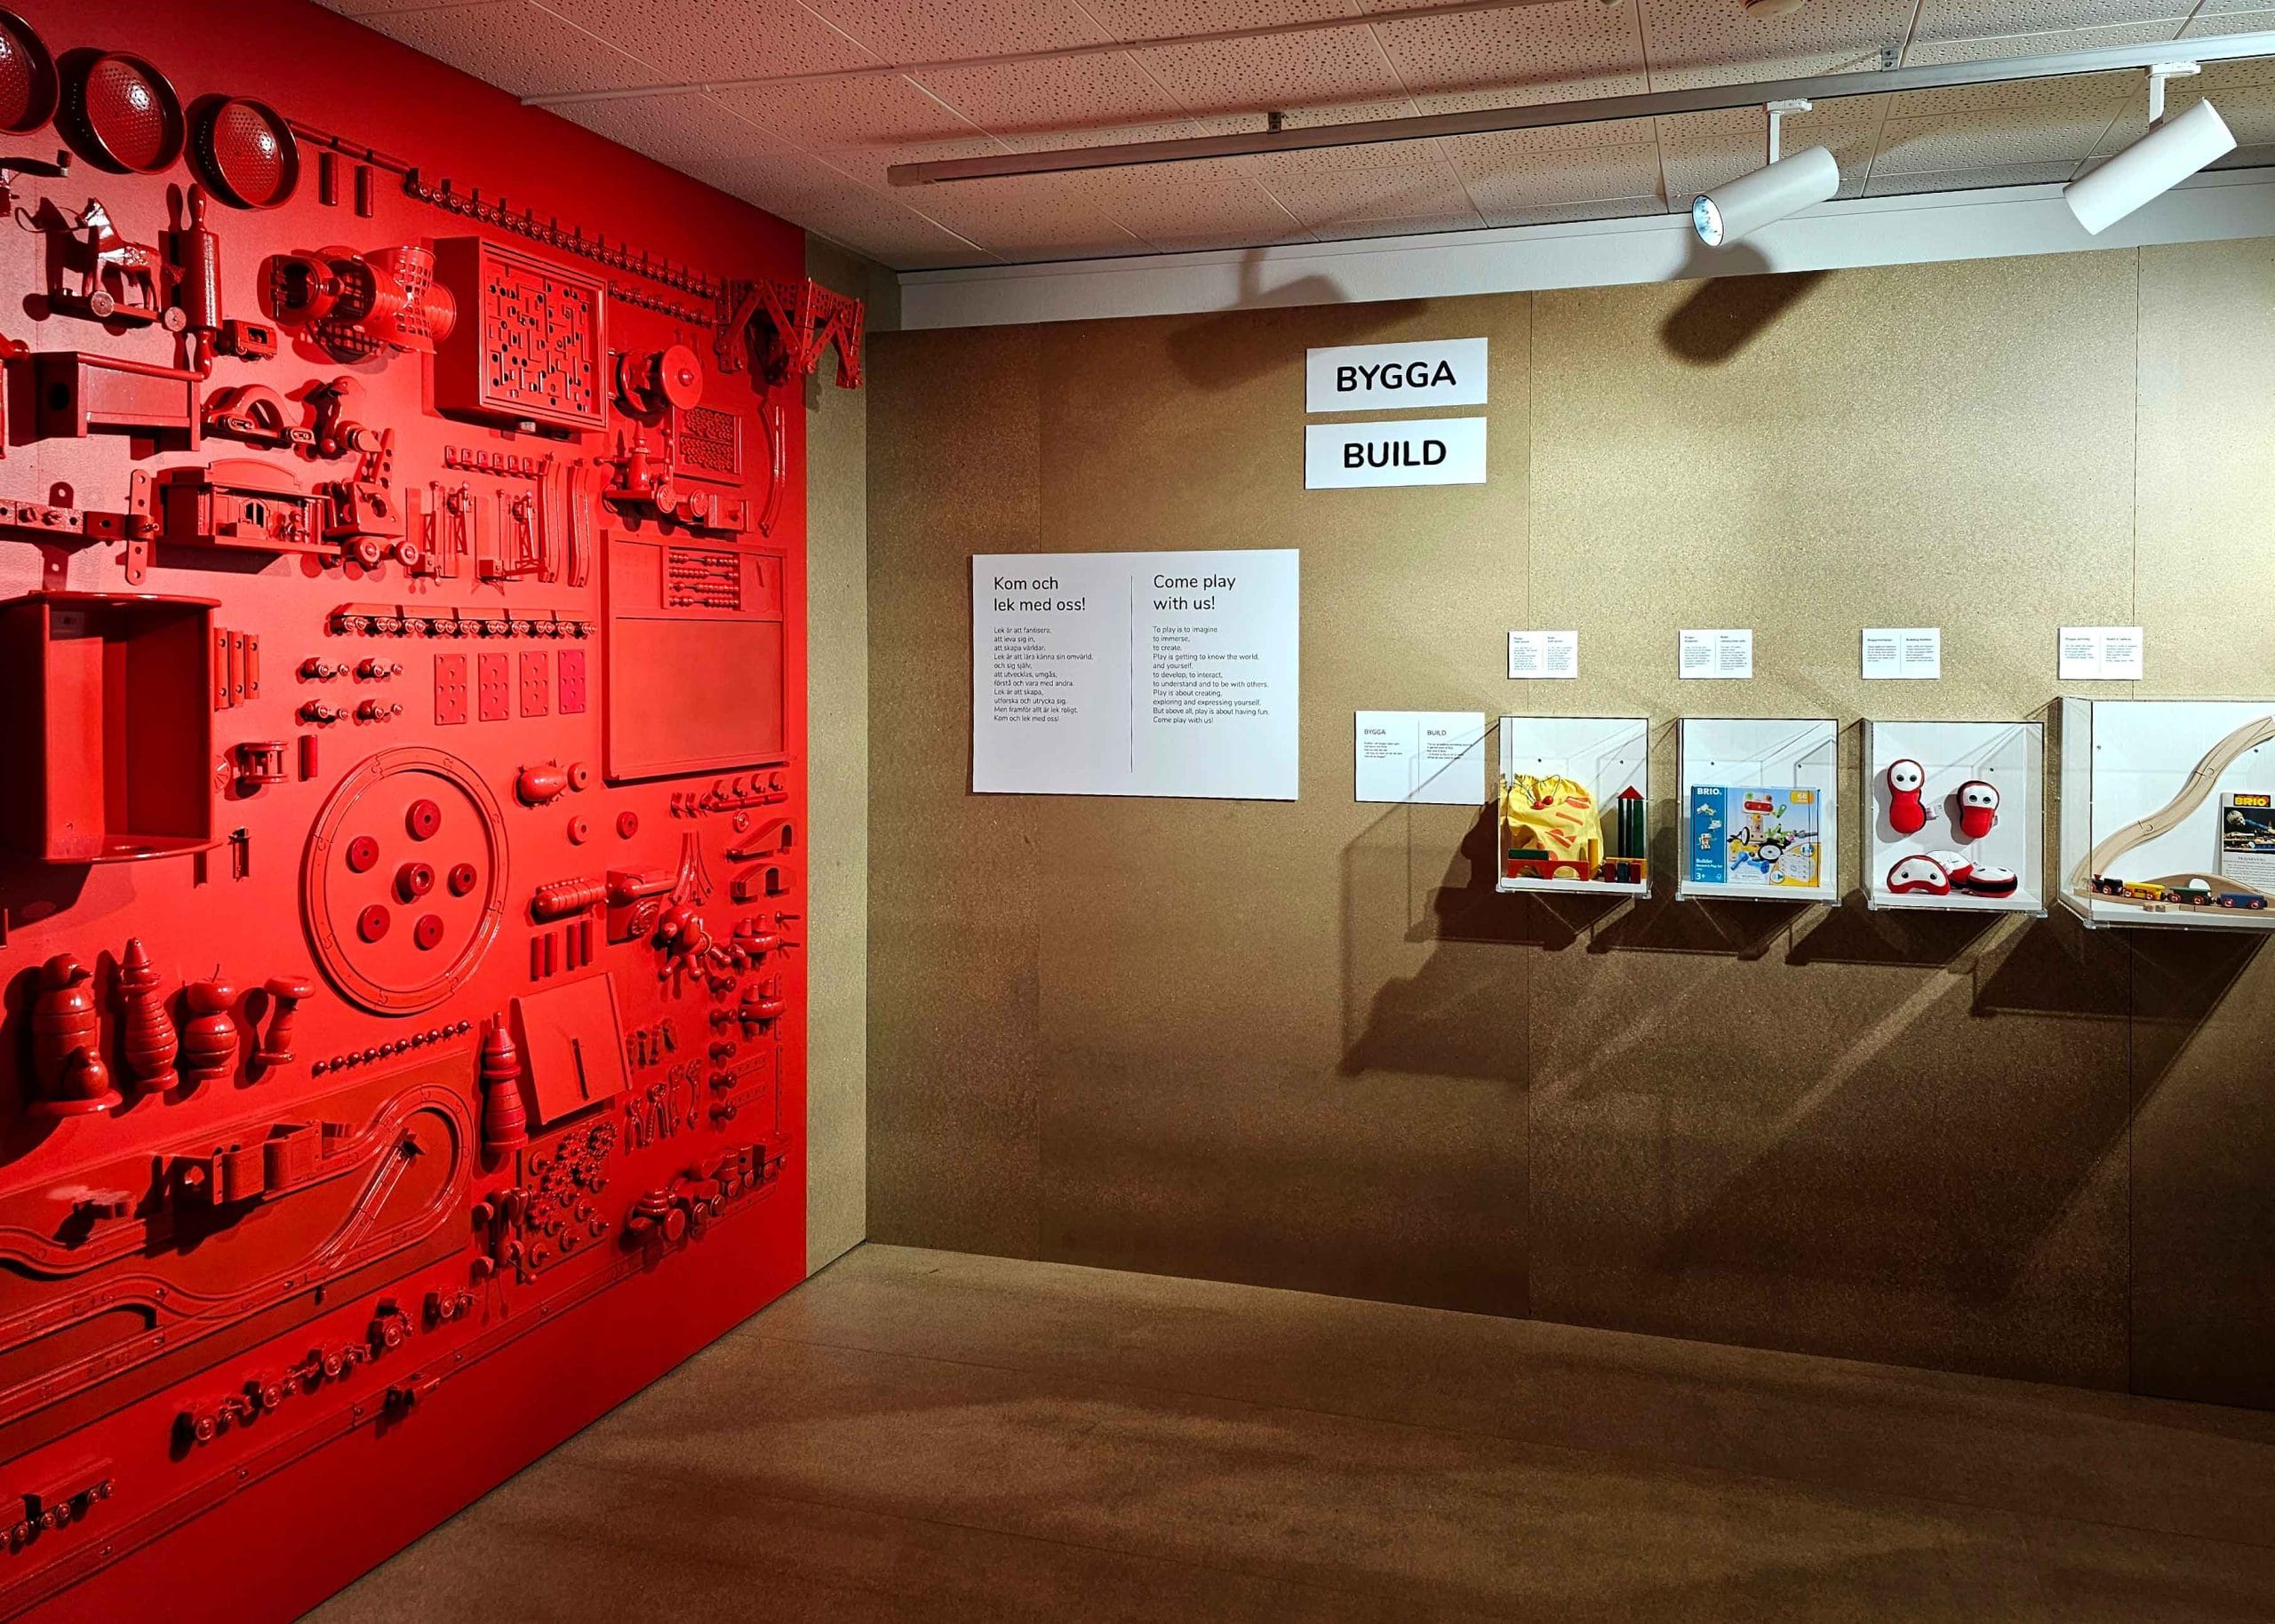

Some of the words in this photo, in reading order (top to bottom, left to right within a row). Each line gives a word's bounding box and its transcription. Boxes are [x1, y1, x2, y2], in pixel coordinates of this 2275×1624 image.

[1337, 360, 1457, 392] BYGGA
[1344, 440, 1447, 468] BUILD
[994, 576, 1028, 590] Kom
[1032, 577, 1058, 590] och
[1153, 574, 1198, 589] Come
[1203, 574, 1236, 592] play
[994, 598, 1015, 611] lek
[1020, 597, 1051, 611] med
[1057, 597, 1086, 611] oss!
[1153, 596, 1188, 610] with
[1193, 596, 1216, 610] us!
[2235, 797, 2266, 806] BRIO
